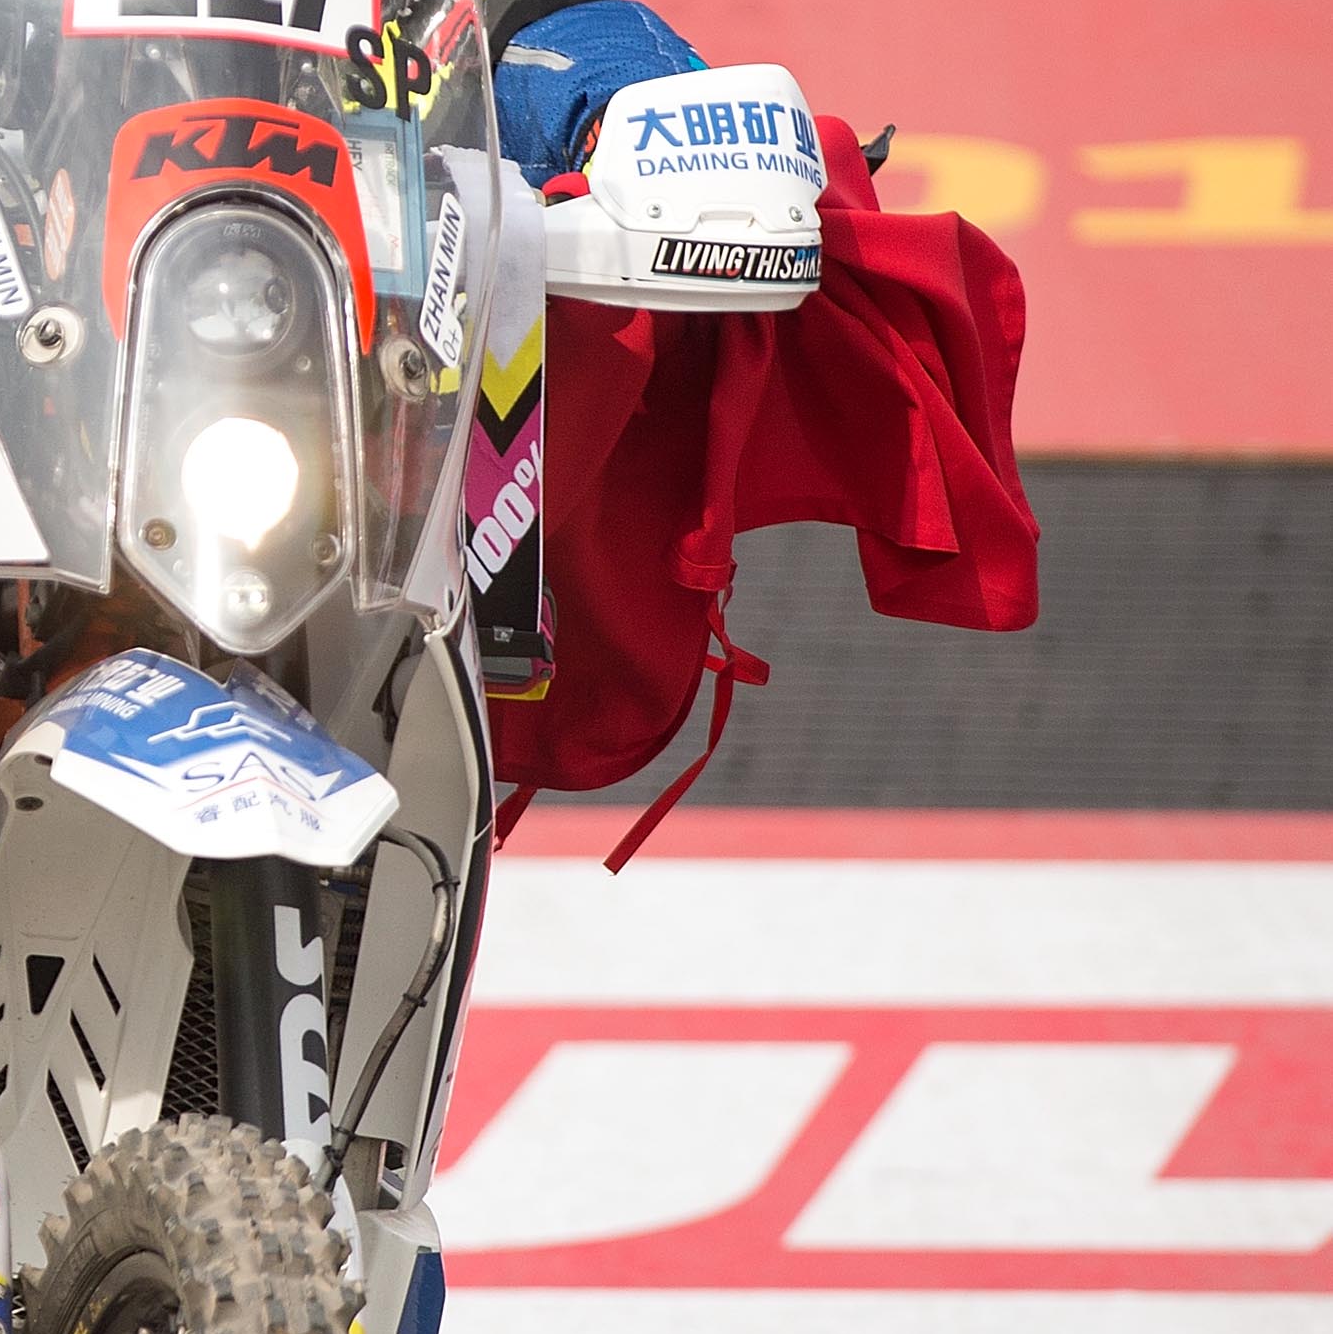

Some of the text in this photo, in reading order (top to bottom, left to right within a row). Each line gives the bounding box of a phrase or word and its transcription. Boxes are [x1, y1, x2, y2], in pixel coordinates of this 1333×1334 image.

[346, 23, 433, 123] SP
[129, 114, 340, 188] KTM
[627, 101, 820, 164] 大明矿业
[636, 151, 823, 190] DAMING MINING
[424, 202, 462, 342] ZHAN MIN
[180, 751, 317, 802] SAS
